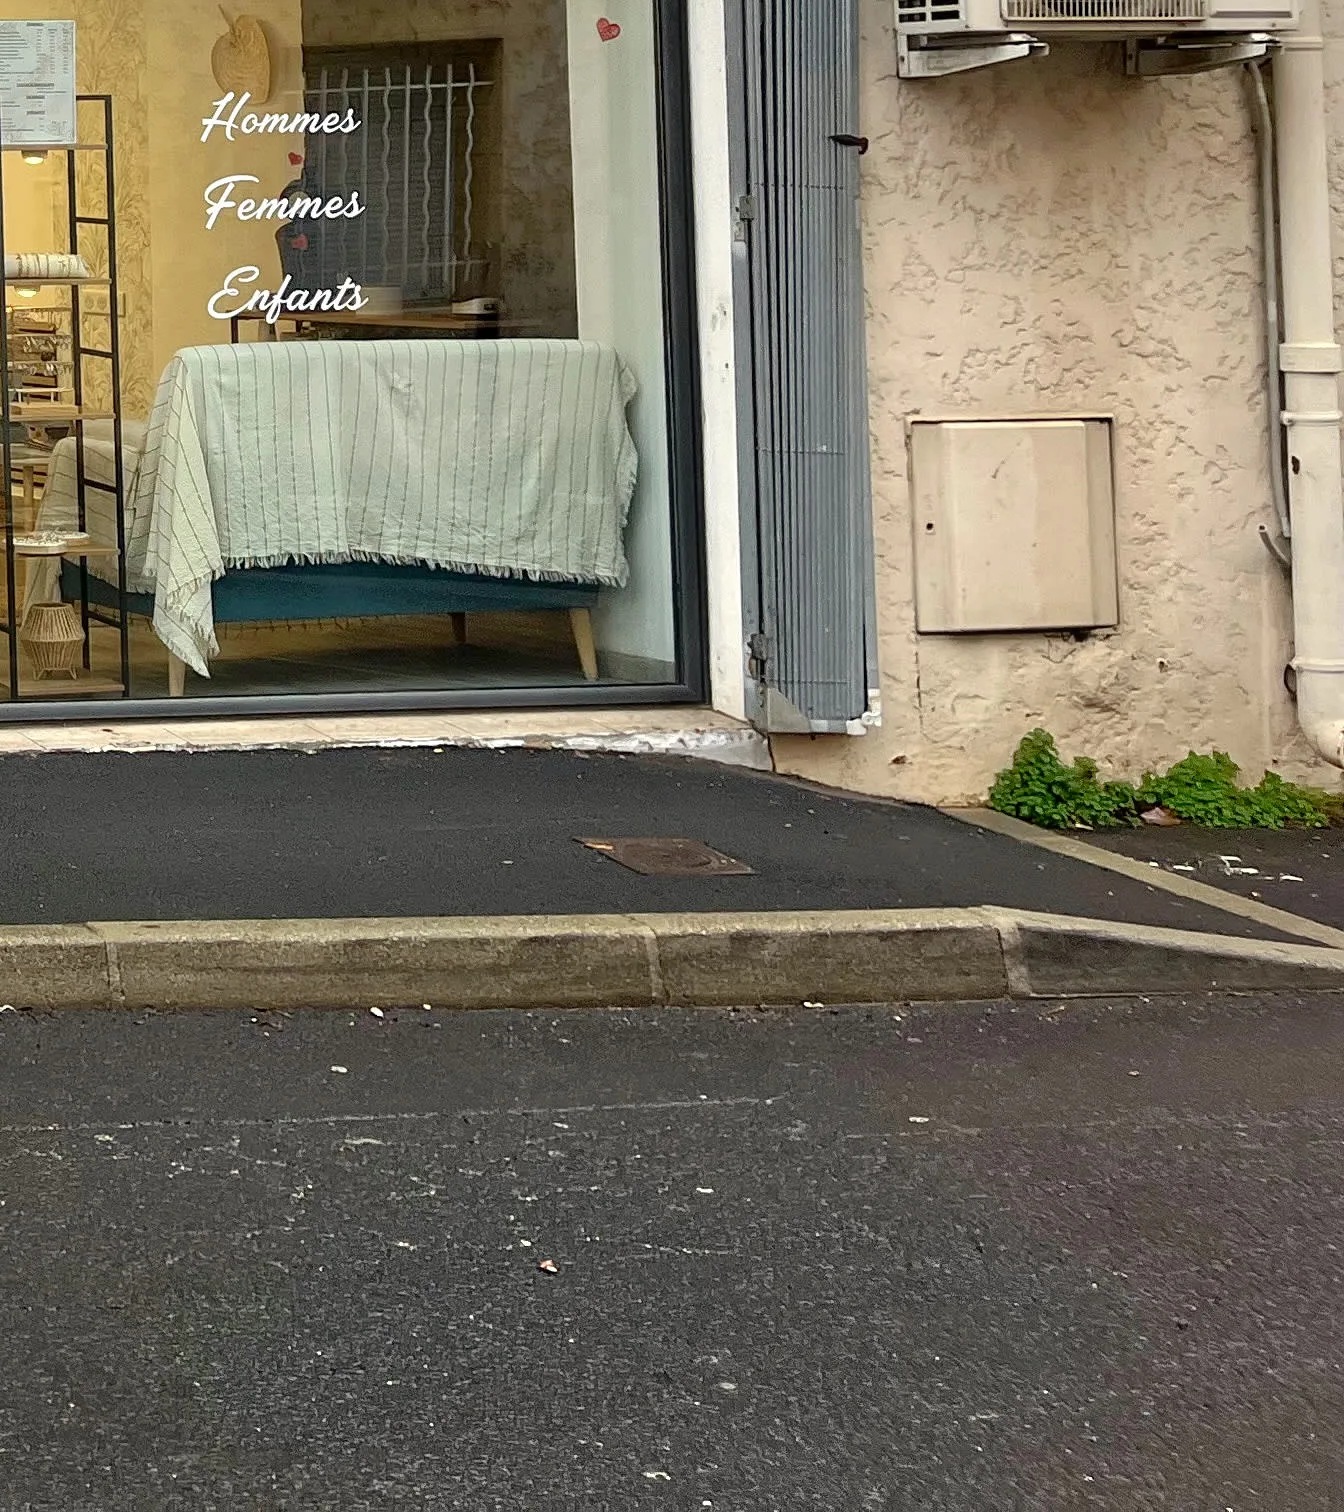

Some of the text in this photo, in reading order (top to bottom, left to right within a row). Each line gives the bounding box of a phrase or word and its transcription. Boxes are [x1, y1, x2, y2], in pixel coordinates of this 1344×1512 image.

[200, 90, 362, 144] Hommes
[204, 174, 366, 231] Femmes
[207, 265, 369, 324] Enfants
